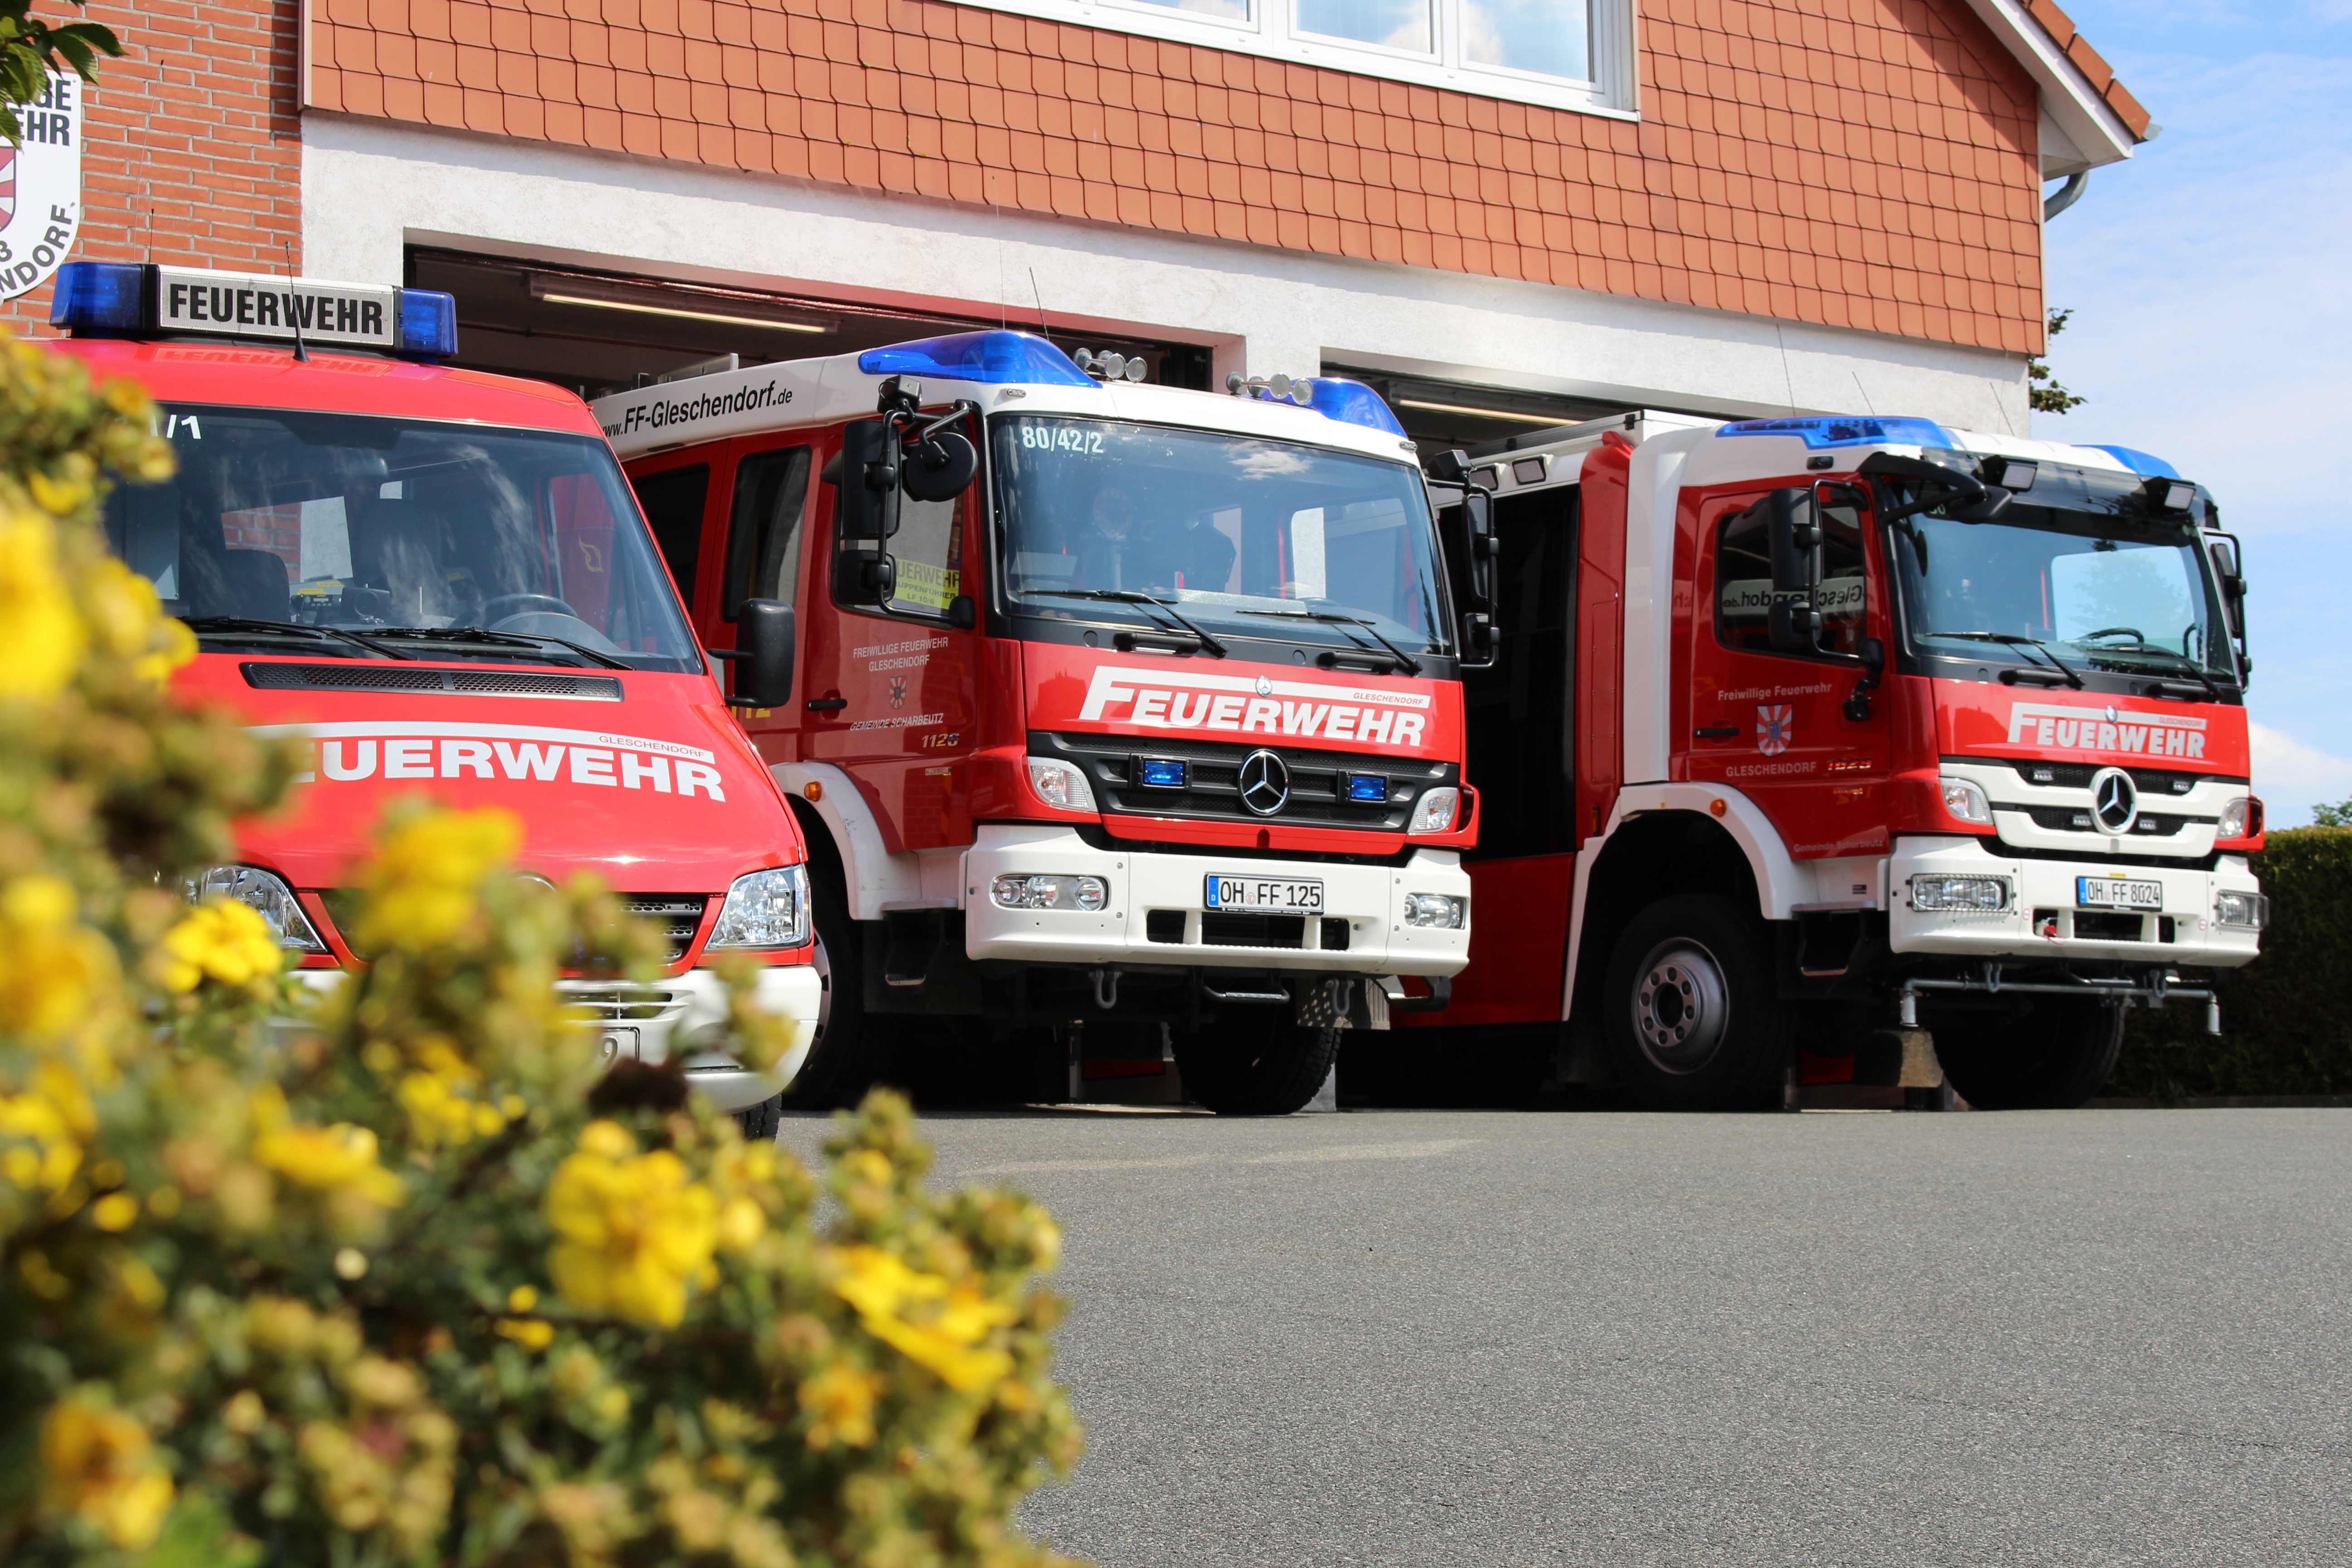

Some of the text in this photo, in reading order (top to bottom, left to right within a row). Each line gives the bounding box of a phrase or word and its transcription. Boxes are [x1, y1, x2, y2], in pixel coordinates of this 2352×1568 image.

[170, 283, 382, 335] FEUERWEHR
[602, 380, 792, 437] ww.FF-Gleschendorf.de
[1022, 426, 1103, 454] 80/42/2
[897, 561, 960, 588] UERWEHR
[896, 581, 956, 598] UPPENFÜHRER
[853, 637, 948, 658] FREIWILLIGE FEUERWEHR
[869, 655, 930, 671] GLESCHENDORF
[1353, 692, 1424, 705] GLESCHENDORF
[1718, 682, 1832, 700] Freiwillige Feuerwehr
[1079, 665, 1431, 747] FEUERWEHR
[850, 713, 944, 731] GEMEINDE SCHARBEUTZ
[2007, 702, 2206, 759] FEUERWEHR
[599, 736, 705, 758] GLESCHENDORF
[922, 733, 960, 748] 1126
[254, 720, 726, 802] UERWEHR
[1726, 762, 1817, 777] GLESCHENDORF
[1794, 842, 1834, 852] Gemeinde
[1220, 881, 1244, 903] OH
[1257, 883, 1281, 905] FF
[1286, 885, 1320, 906] 125
[2088, 882, 2103, 900] OH
[2112, 883, 2127, 902] FF
[2131, 884, 2159, 904] 8024
